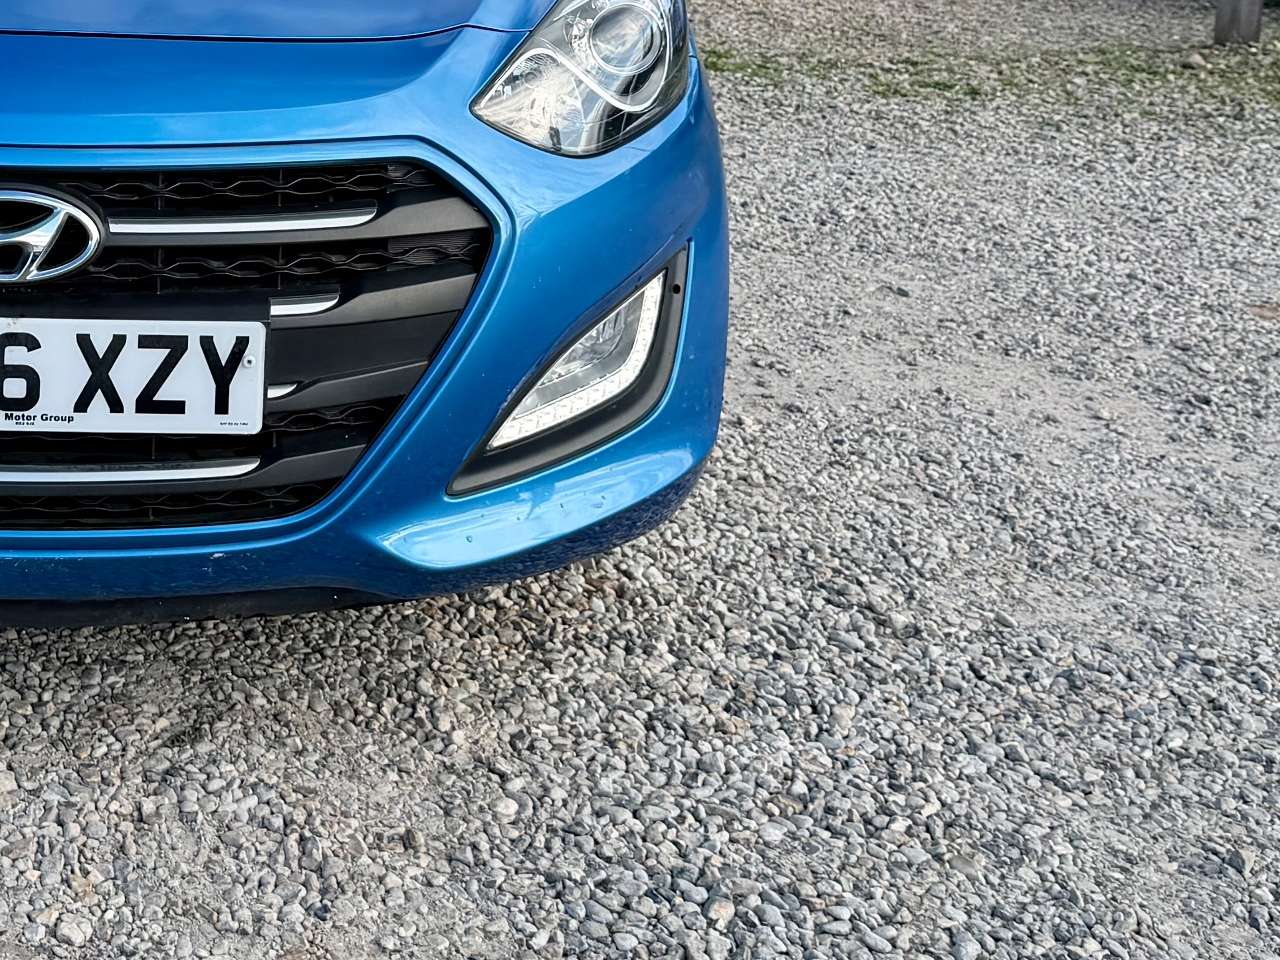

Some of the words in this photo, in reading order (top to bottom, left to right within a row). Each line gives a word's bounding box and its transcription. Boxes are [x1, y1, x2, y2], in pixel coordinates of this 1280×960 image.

[72, 333, 251, 415] XZY
[4, 412, 37, 422] Motor
[40, 413, 75, 424] Group
